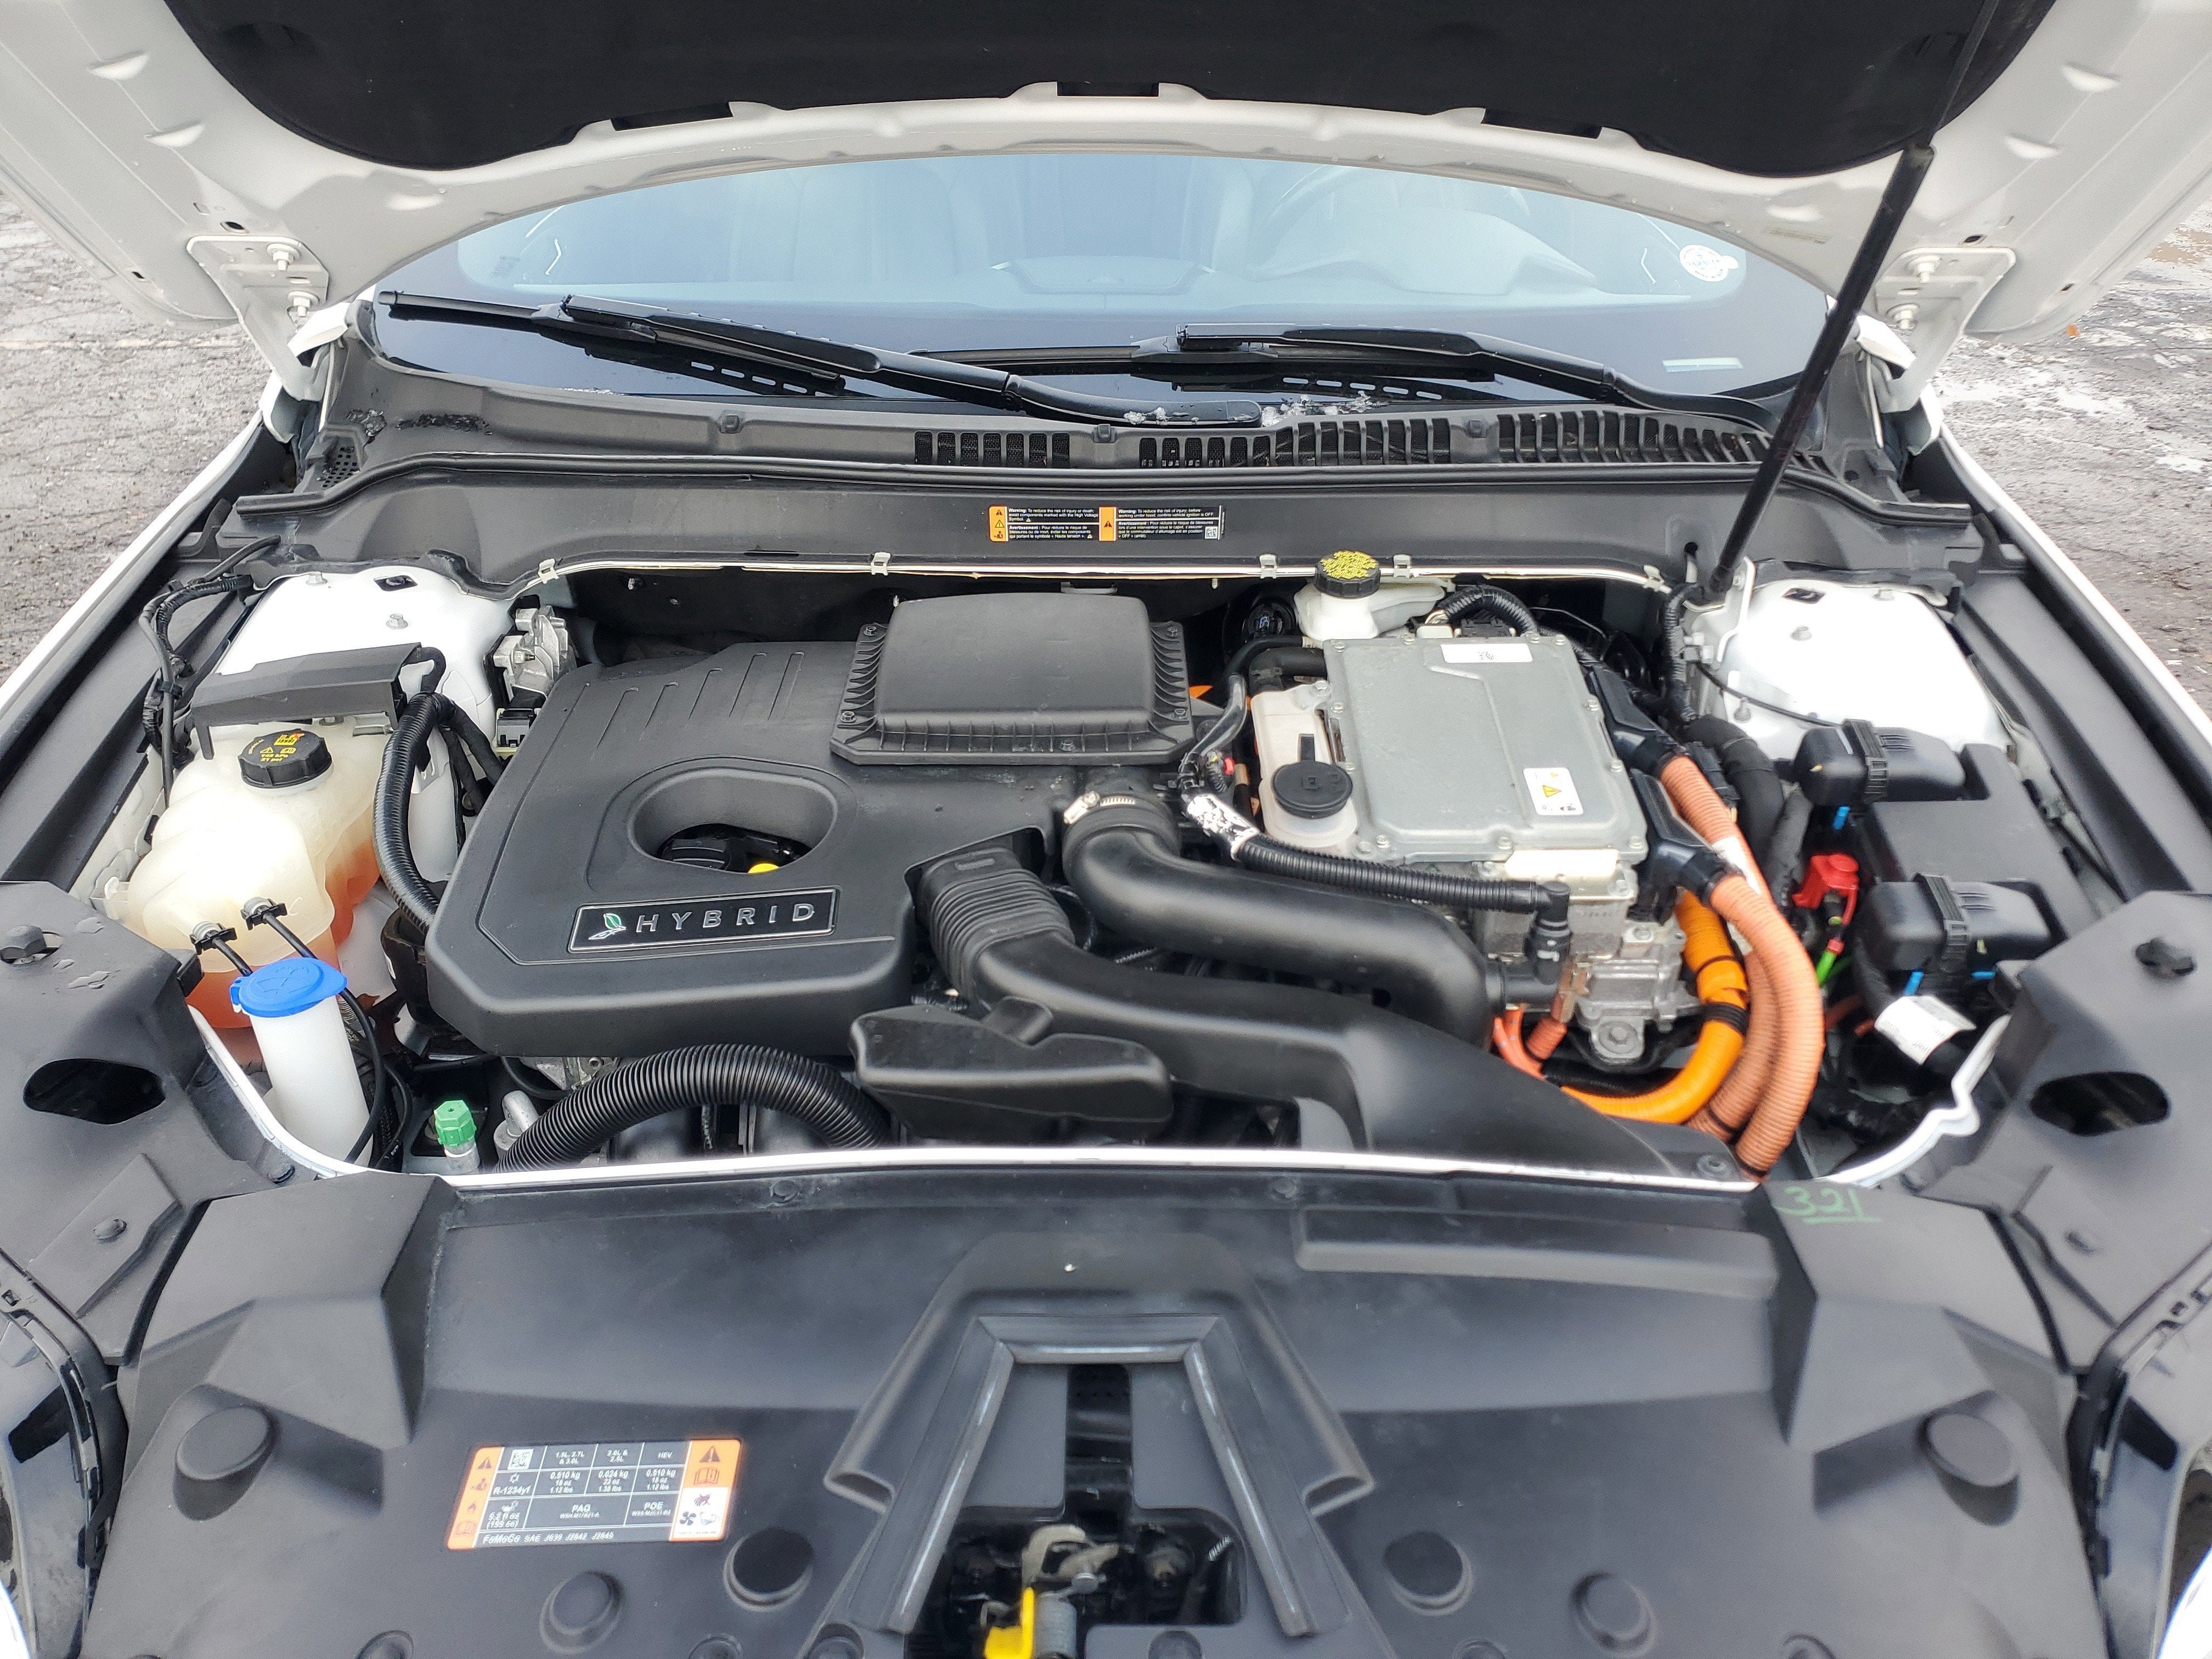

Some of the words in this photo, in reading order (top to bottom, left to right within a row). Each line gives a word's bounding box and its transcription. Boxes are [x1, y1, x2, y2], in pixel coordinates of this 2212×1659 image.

[636, 903, 816, 933] HYBRID
[1771, 1186, 1865, 1219] 321
[571, 1471, 580, 1480] kg
[619, 1470, 629, 1479] kg
[667, 1468, 676, 1477] kg
[572, 1504, 591, 1513] PAG
[644, 1502, 664, 1510] POE
[483, 1534, 521, 1544] FoMoCo
[544, 1533, 563, 1542] J639
